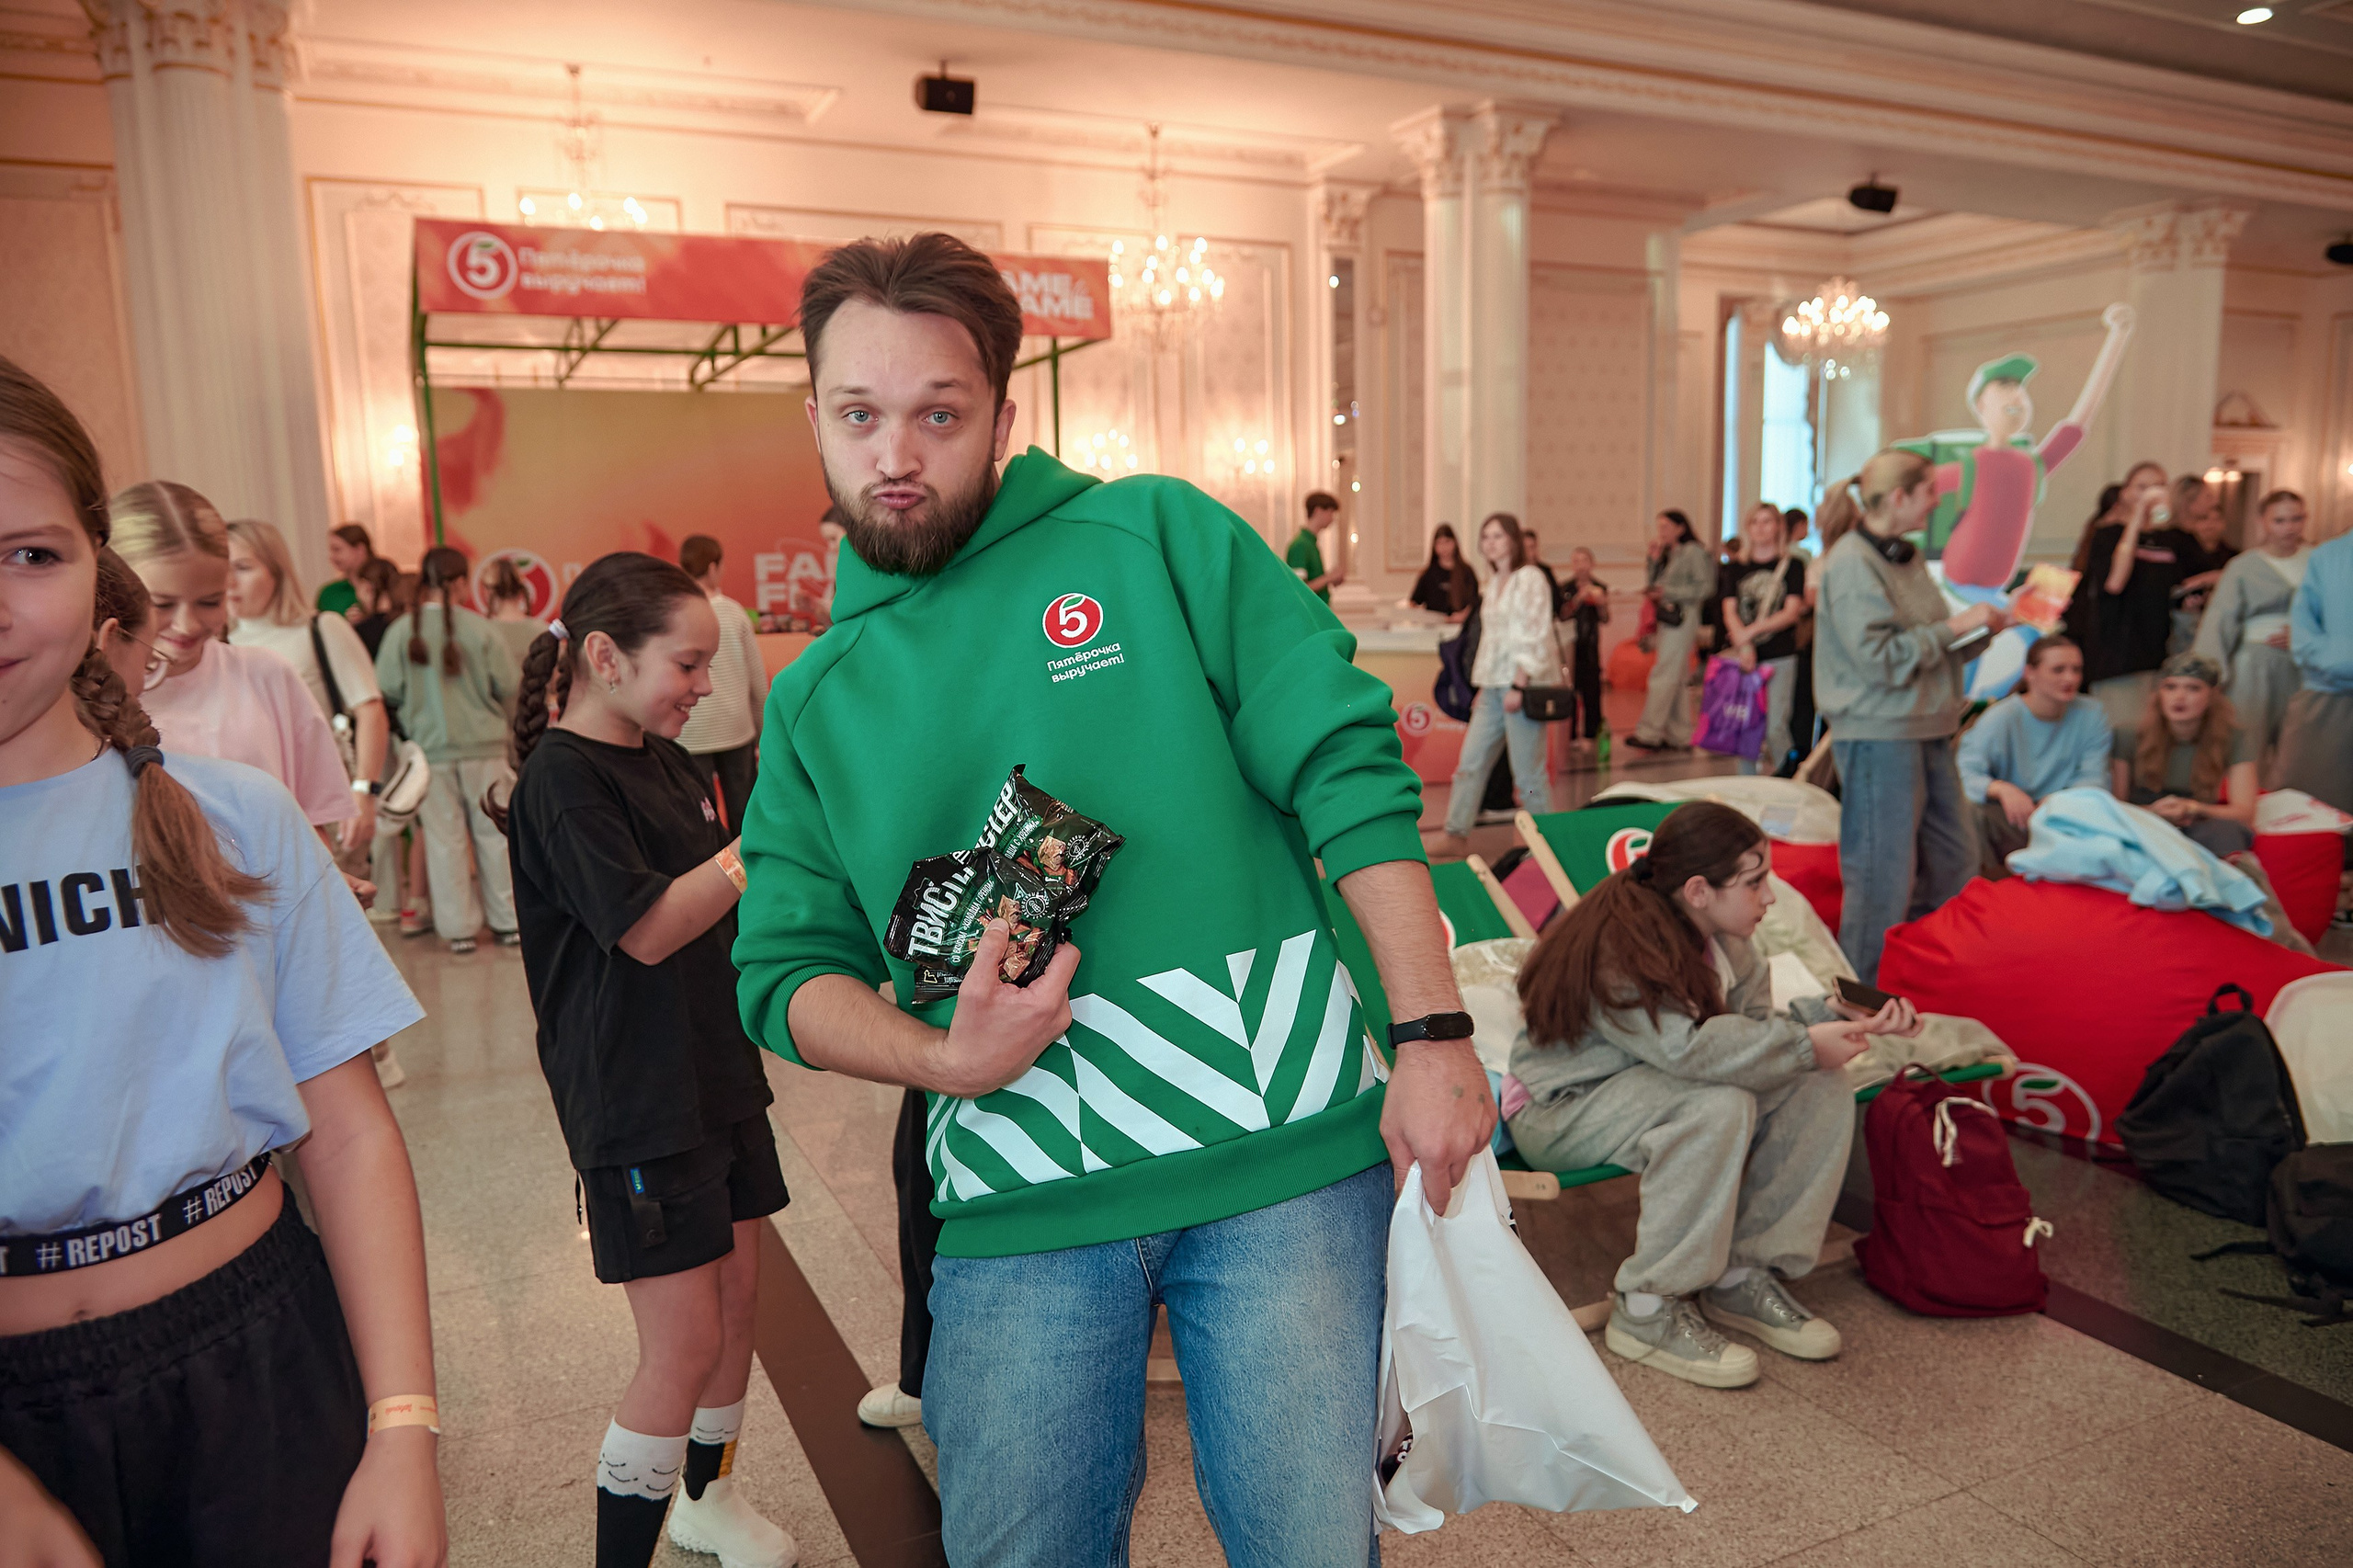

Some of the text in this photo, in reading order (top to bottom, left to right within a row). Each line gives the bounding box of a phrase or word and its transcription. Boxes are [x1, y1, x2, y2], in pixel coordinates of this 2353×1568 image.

[1000, 269, 1073, 297] AME
[1018, 293, 1095, 321] AME
[1047, 642, 1121, 672] Пятёрочка
[1051, 653, 1125, 683] выручает!
